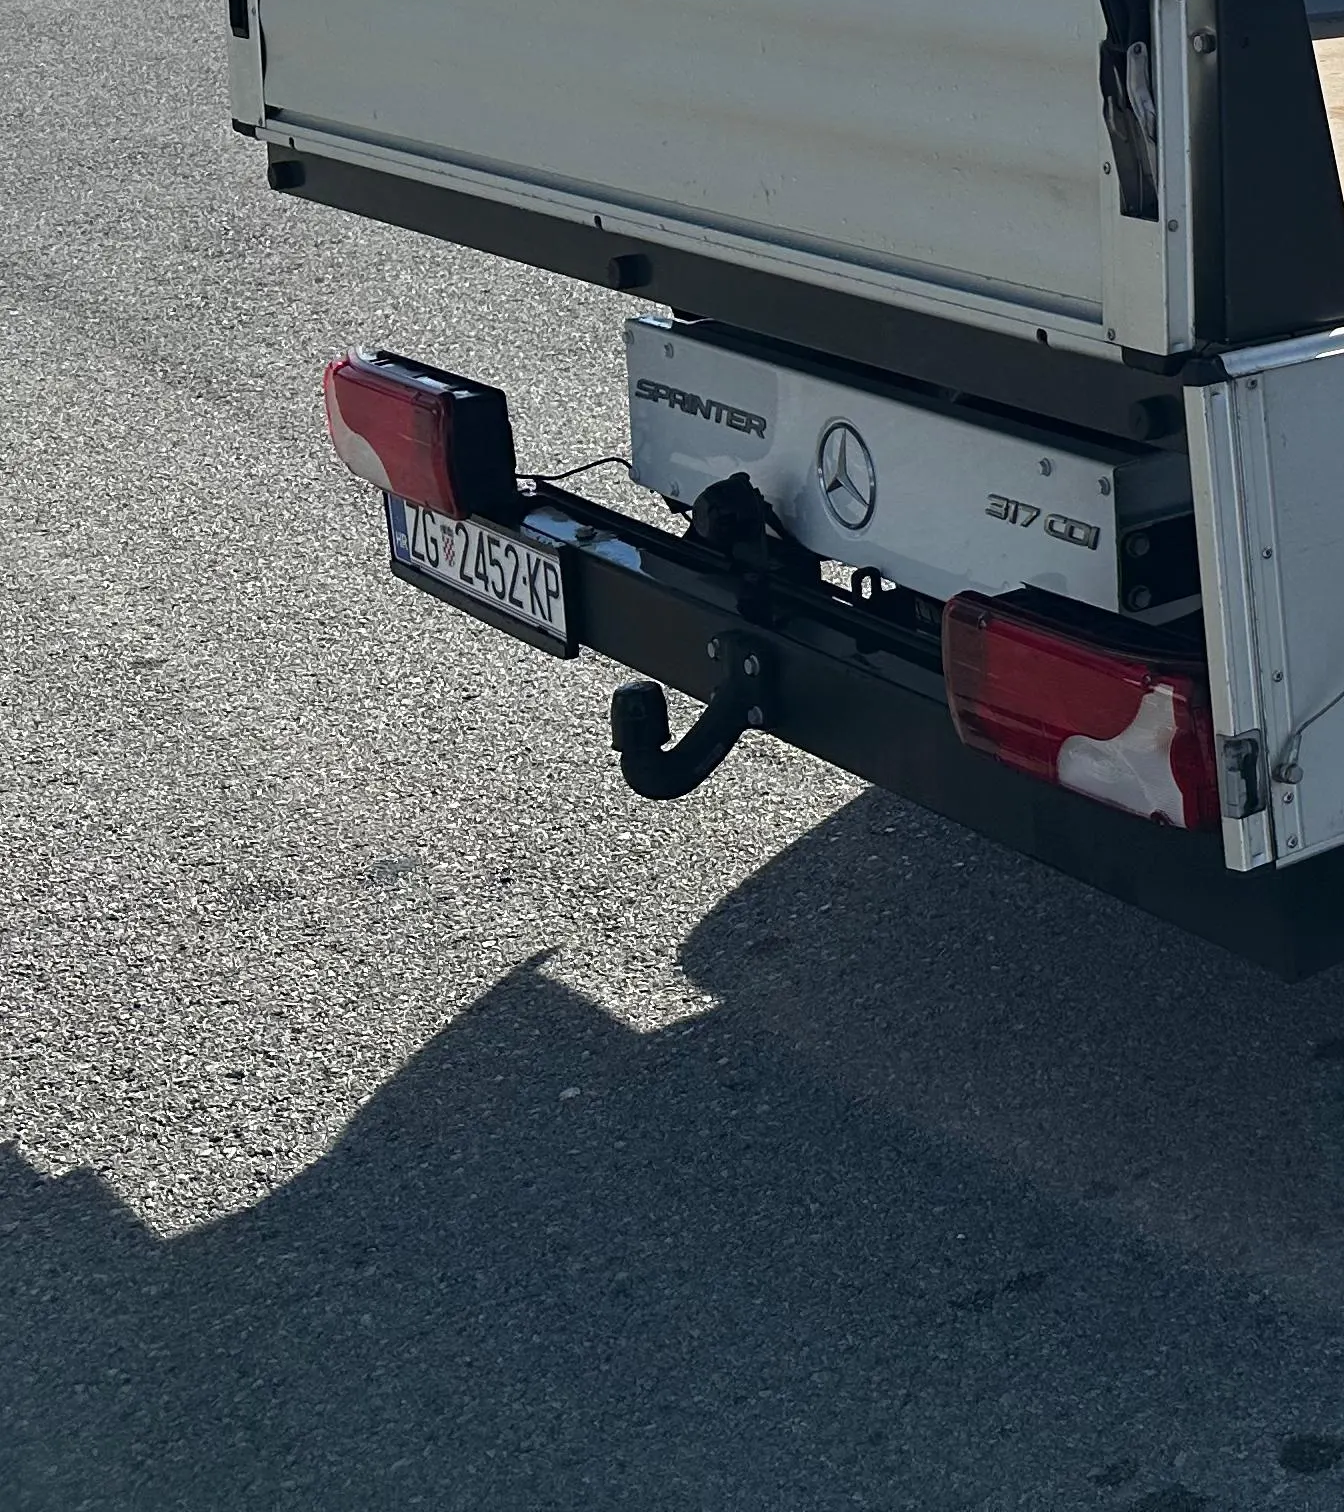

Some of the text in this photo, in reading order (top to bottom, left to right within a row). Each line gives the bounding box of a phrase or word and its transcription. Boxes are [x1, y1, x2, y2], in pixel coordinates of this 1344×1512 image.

[635, 378, 767, 439] SPRINTER
[406, 501, 439, 567] ZG
[985, 493, 1101, 551] 317 CDI
